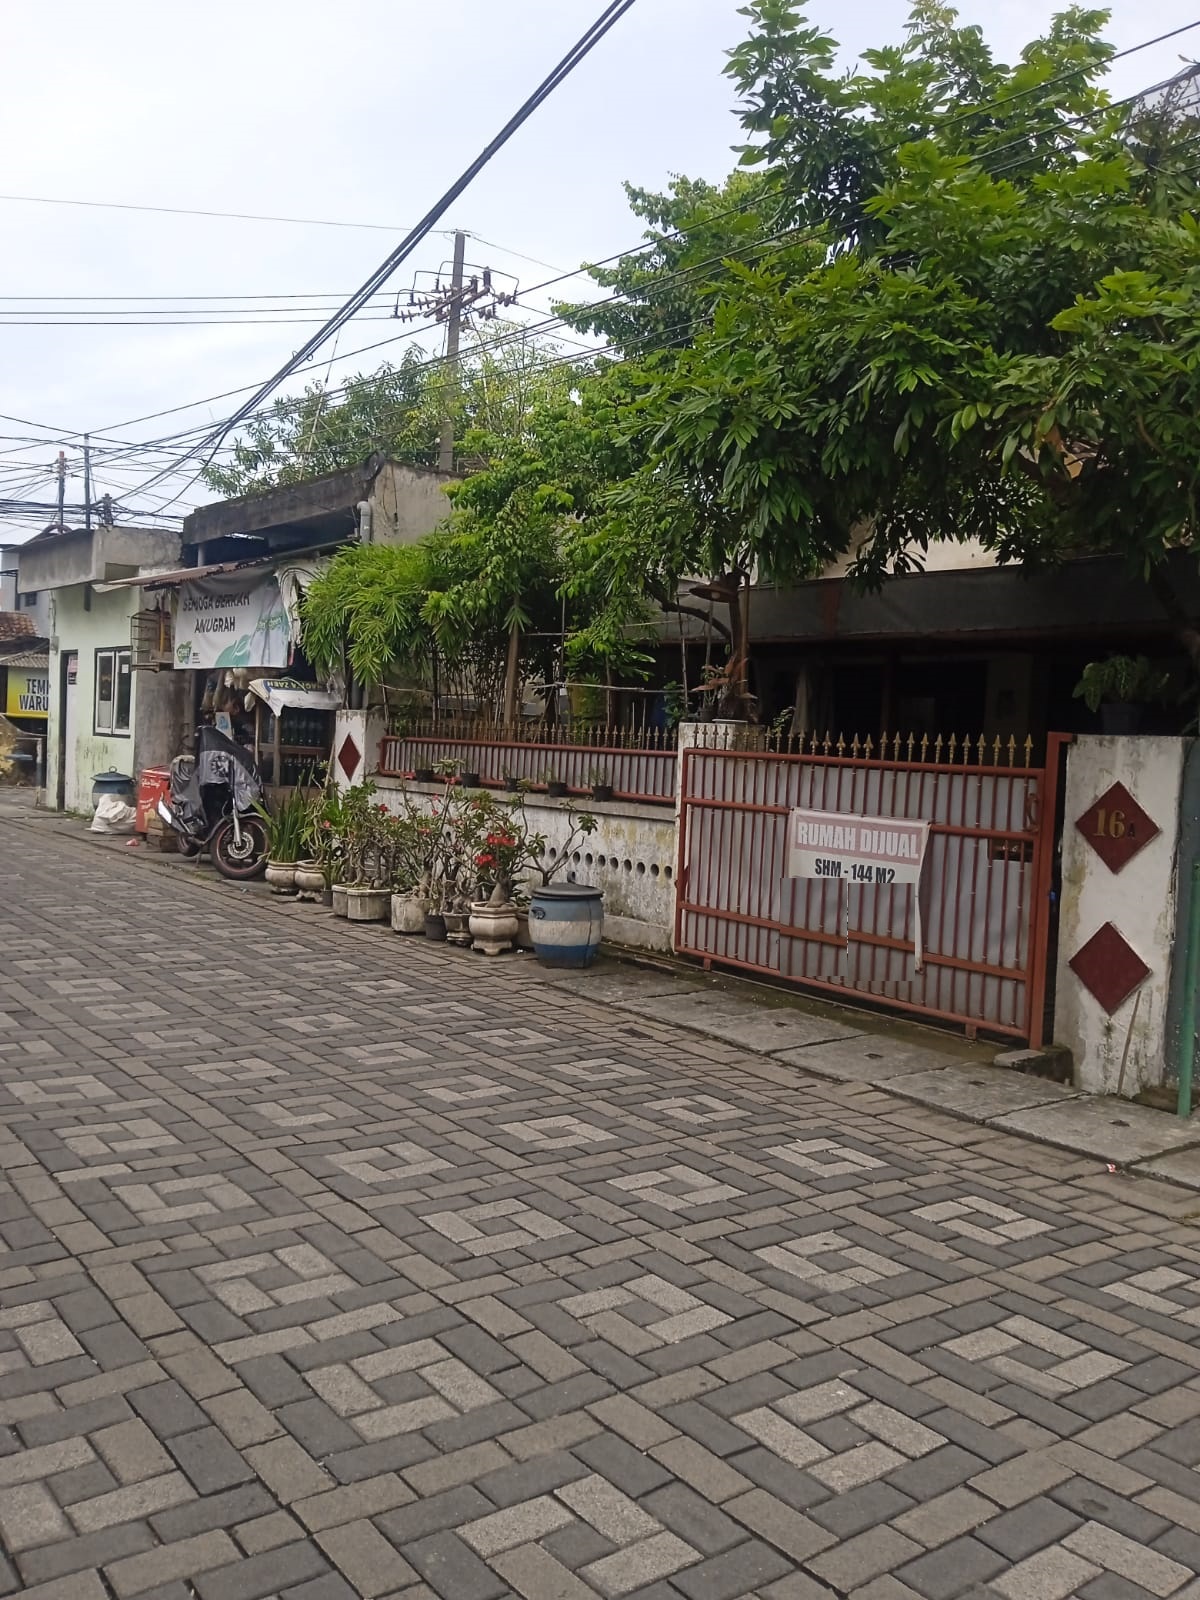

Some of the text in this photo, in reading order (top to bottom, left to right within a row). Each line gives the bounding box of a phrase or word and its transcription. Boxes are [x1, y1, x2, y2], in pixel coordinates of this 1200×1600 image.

[194, 616, 236, 633] ANUGRAH
[797, 821, 919, 859] RUMAH DIJUAL
[814, 858, 842, 877] SHM
[851, 863, 873, 882] 144
[875, 866, 896, 884] M2
